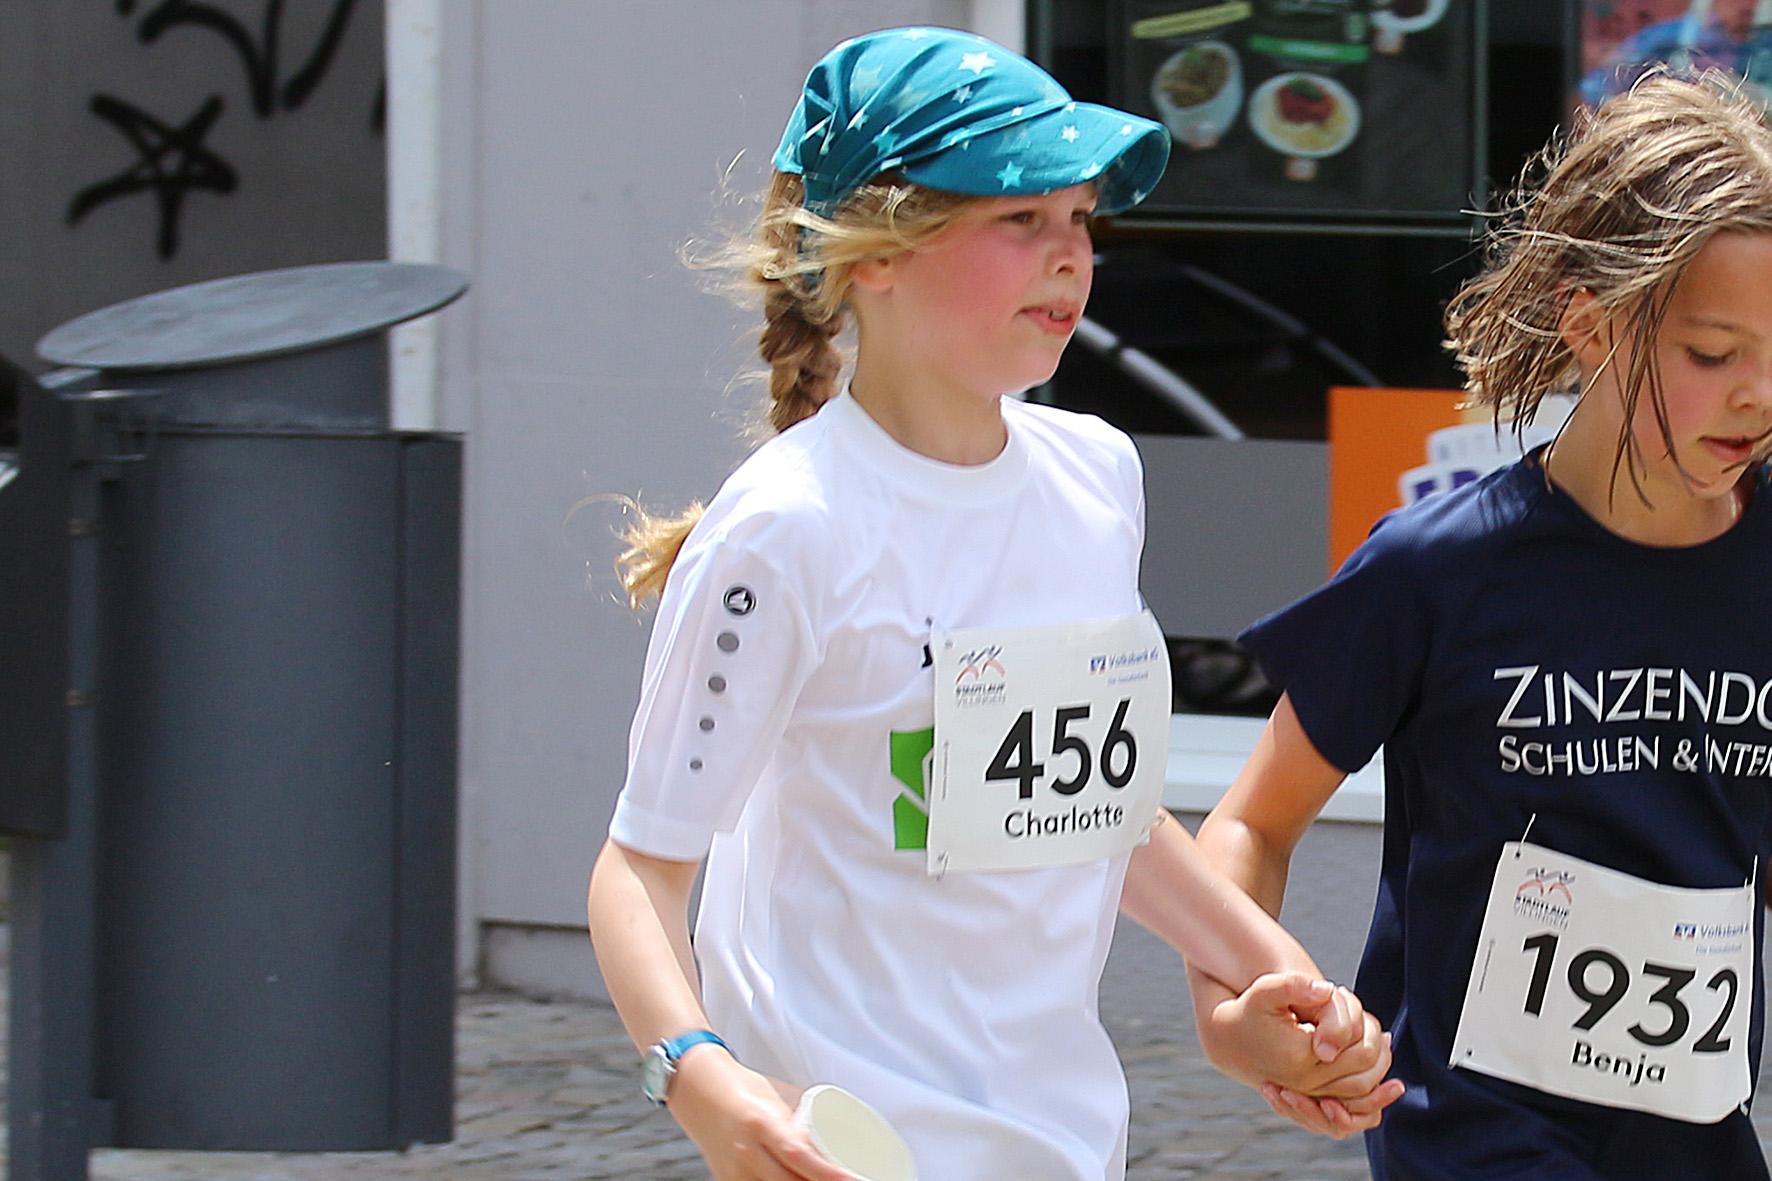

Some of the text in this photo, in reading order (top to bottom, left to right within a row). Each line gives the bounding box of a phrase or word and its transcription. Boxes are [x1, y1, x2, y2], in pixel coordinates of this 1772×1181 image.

[985, 696, 1137, 800] 456
[1499, 734, 1660, 776] SCHULEN
[1672, 738, 1700, 773] &
[1004, 804, 1123, 837] Charlotte
[1521, 933, 1739, 1053] 1932
[1571, 1041, 1667, 1085] Benja
